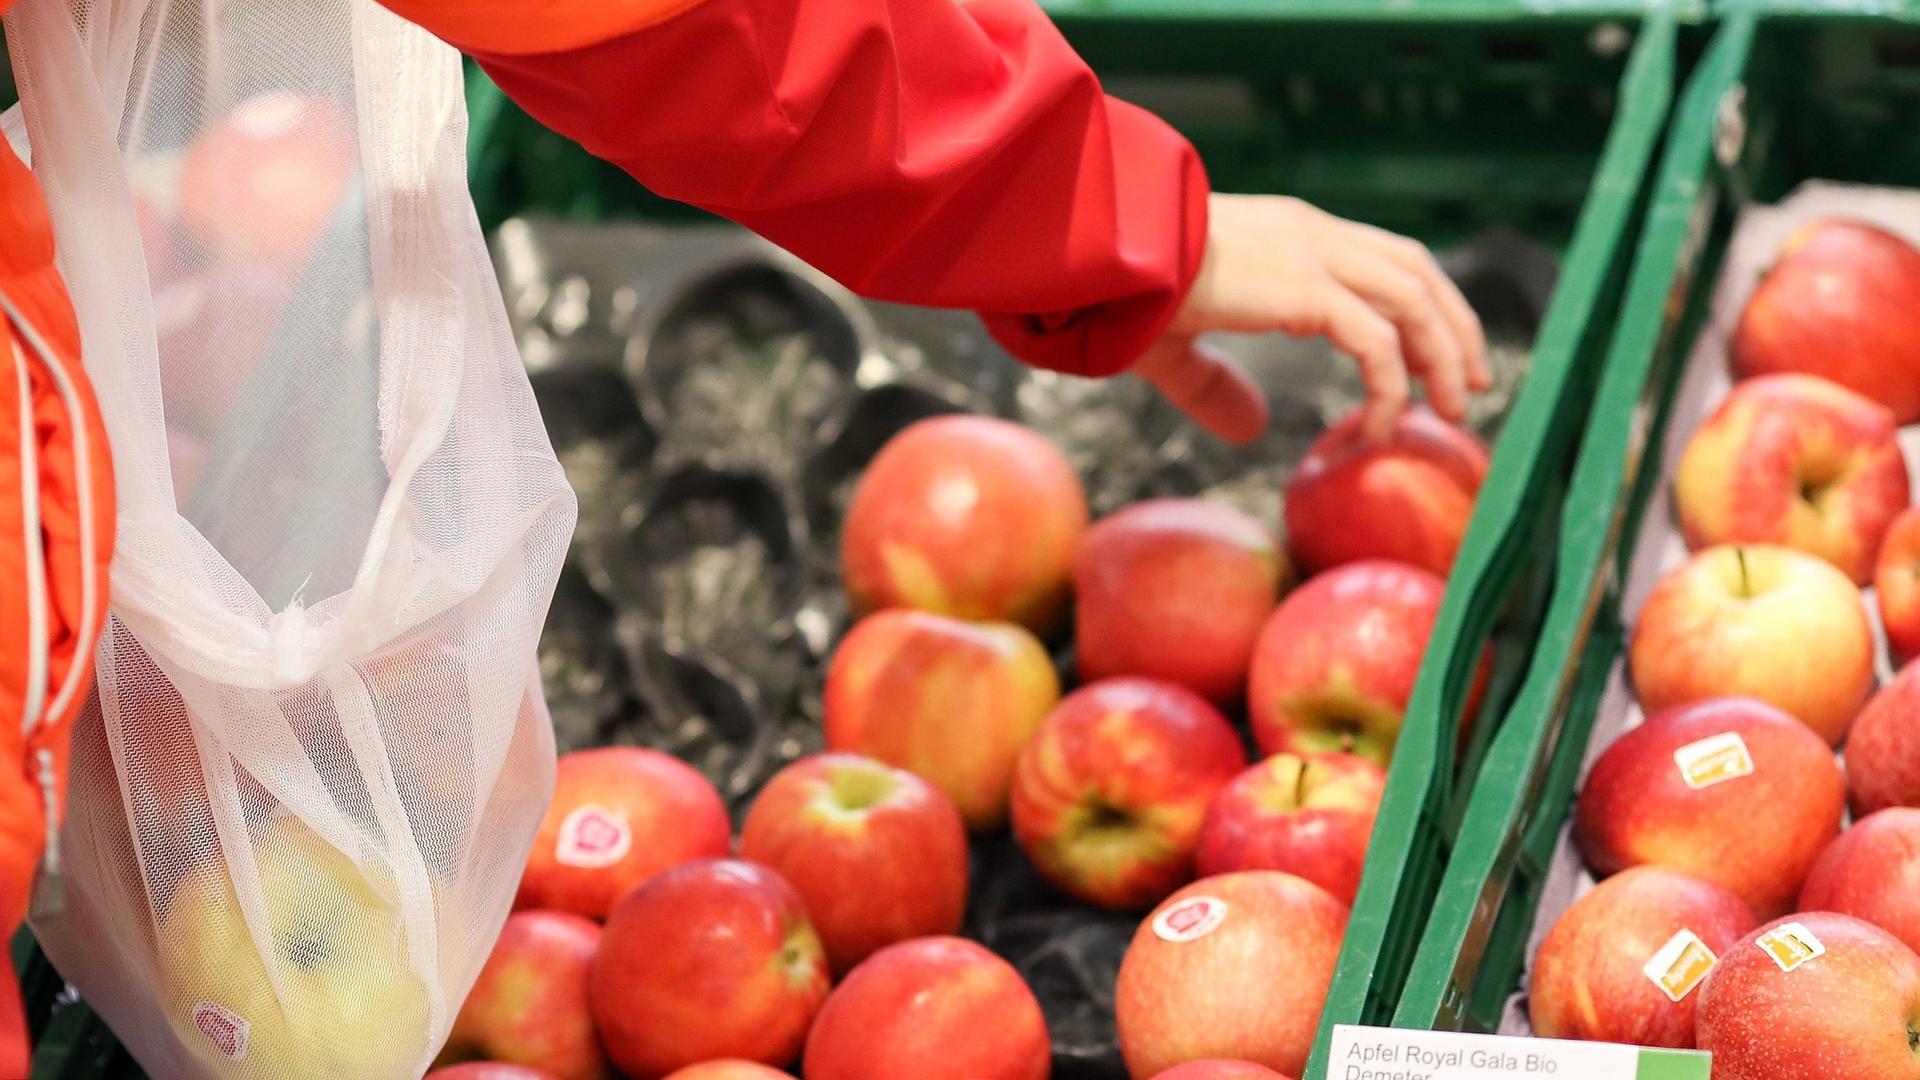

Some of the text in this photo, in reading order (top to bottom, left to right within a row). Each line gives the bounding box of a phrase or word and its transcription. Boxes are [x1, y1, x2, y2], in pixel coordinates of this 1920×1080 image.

[1347, 1042, 1557, 1073] Apfel Royal Gala Bio
